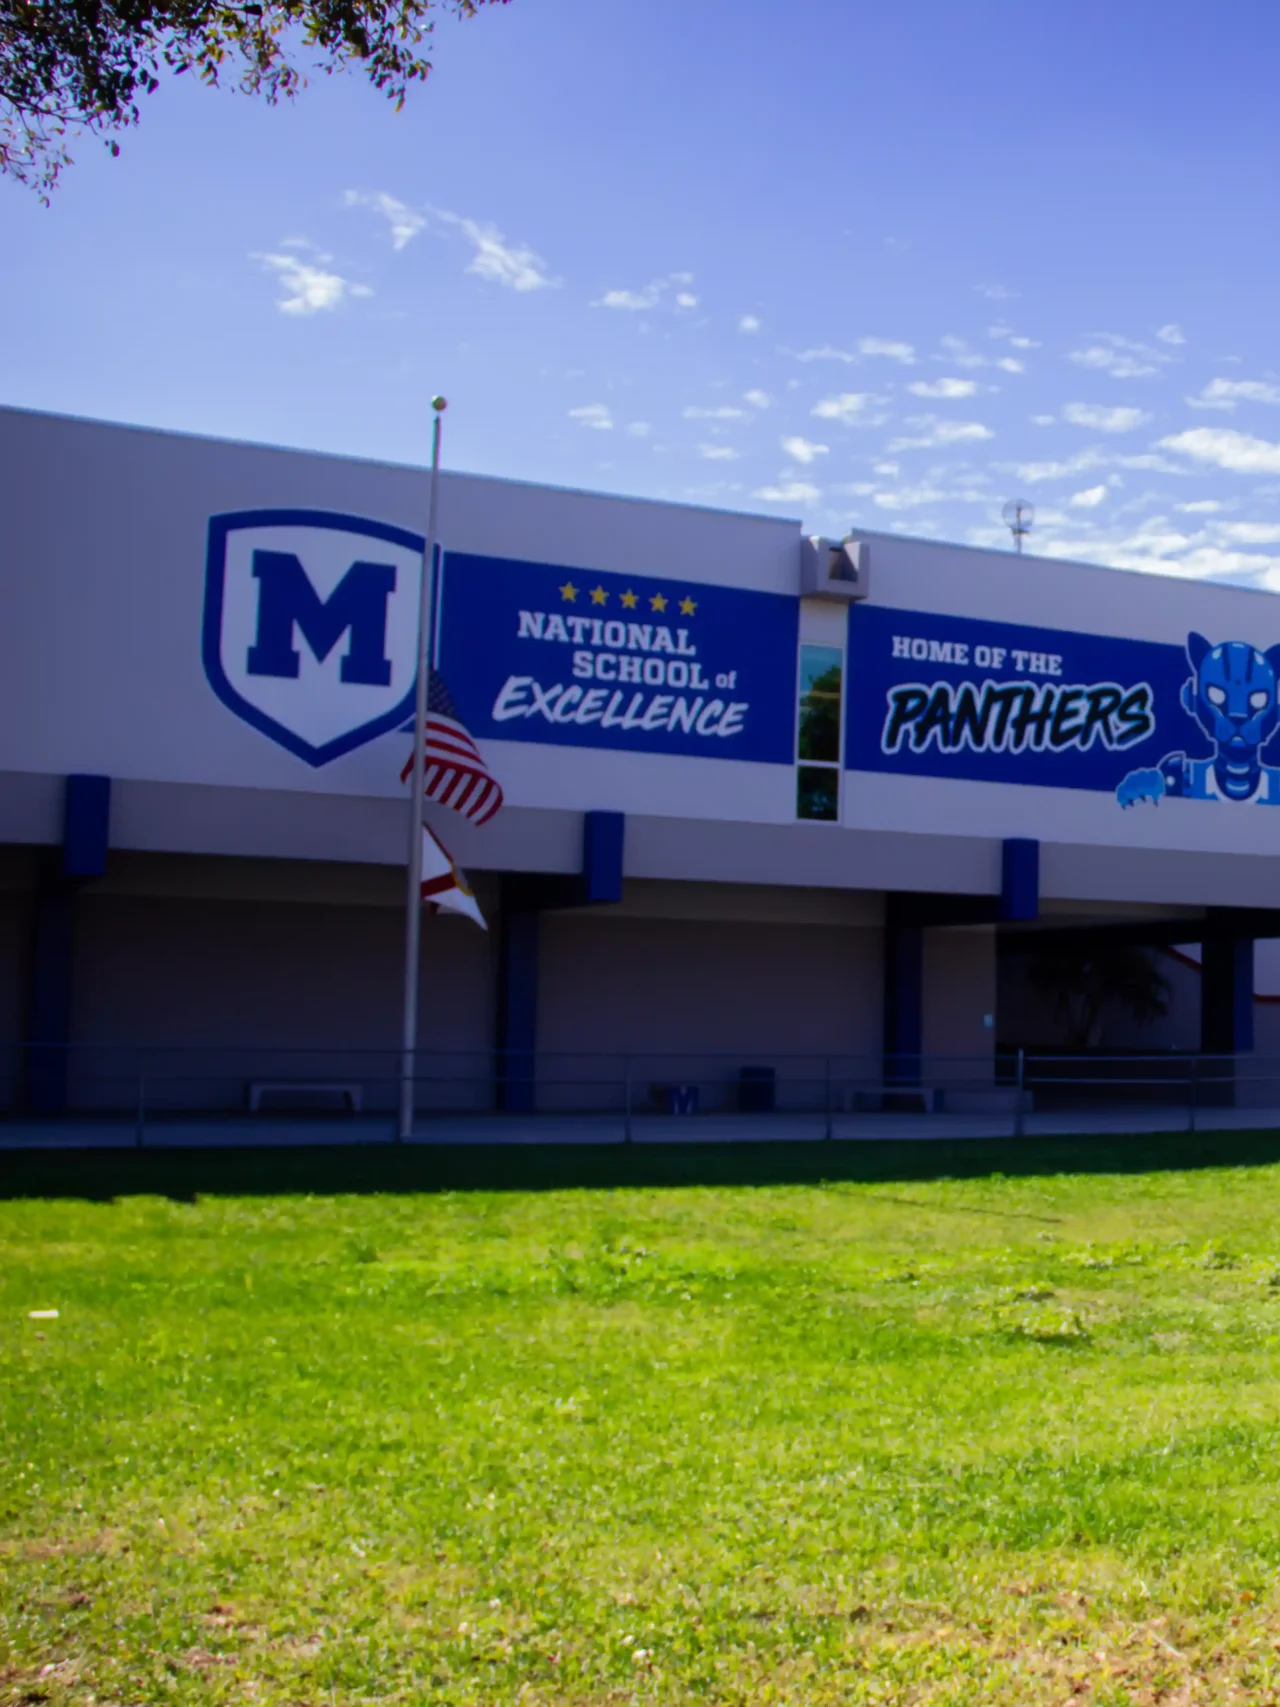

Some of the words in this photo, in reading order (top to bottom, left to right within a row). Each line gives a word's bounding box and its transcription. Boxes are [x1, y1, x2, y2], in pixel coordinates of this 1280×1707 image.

[246, 549, 397, 687] M
[517, 610, 696, 656] NATIONAL
[572, 650, 709, 690] SCHOOL
[715, 671, 737, 689] of
[892, 635, 969, 665] HOME
[974, 646, 1007, 669] OF
[1011, 649, 1063, 676] THE
[492, 675, 749, 737] EXCELLENCE
[881, 679, 1156, 755] PANTHERS
